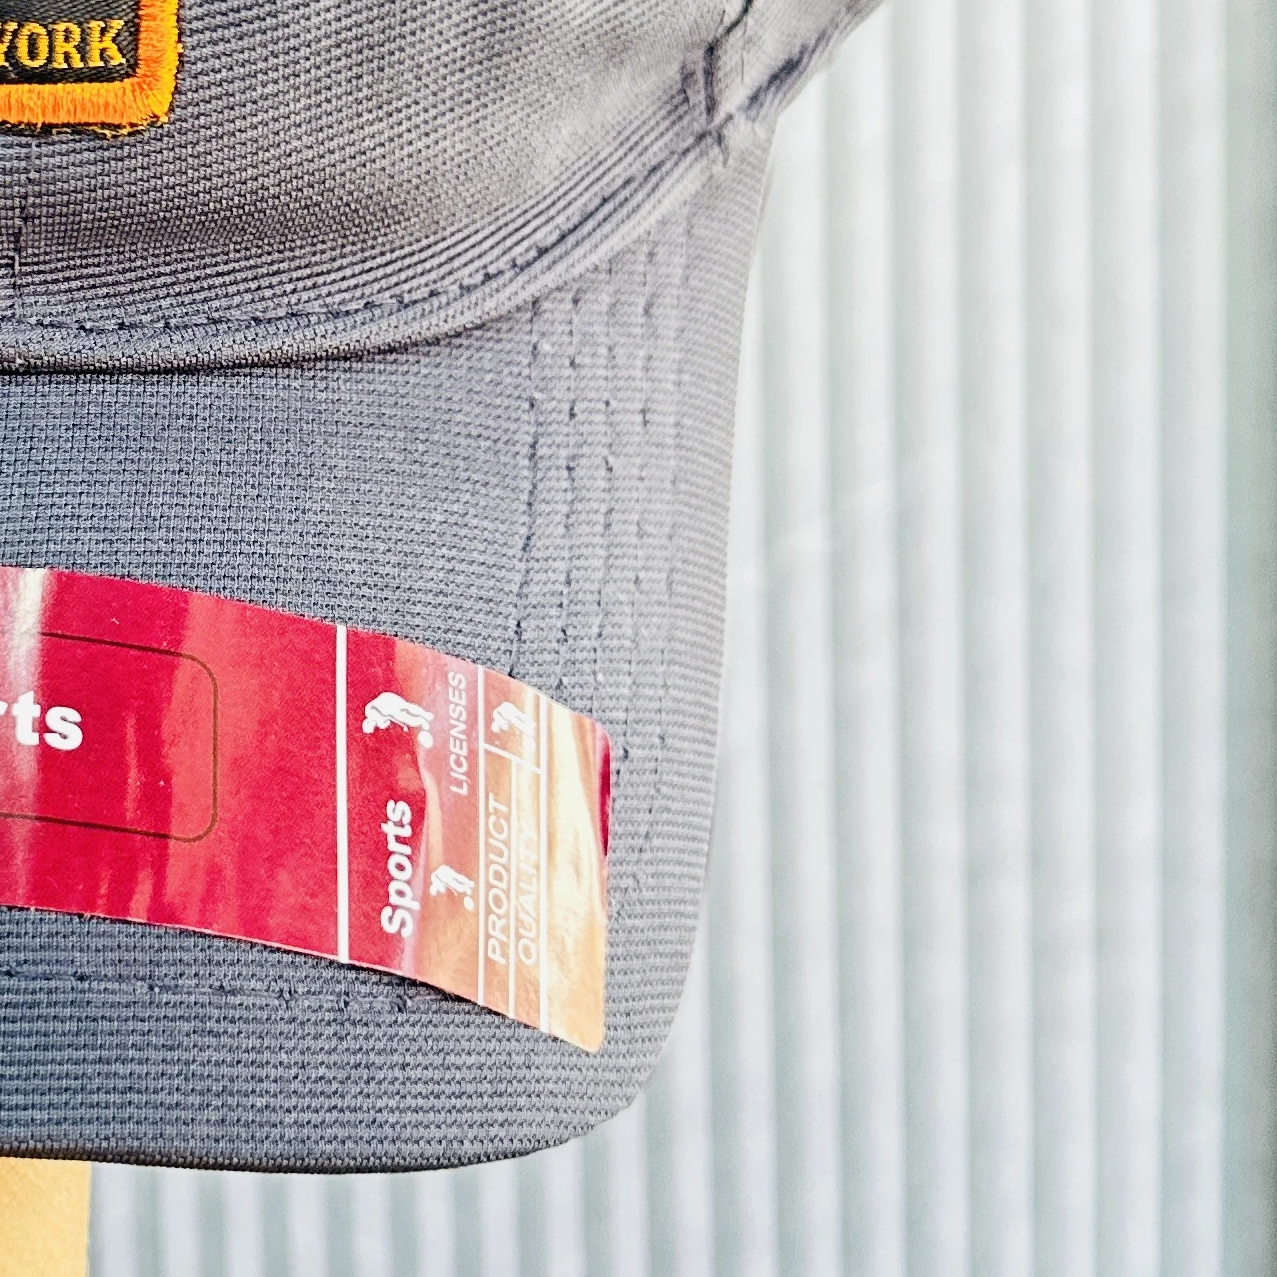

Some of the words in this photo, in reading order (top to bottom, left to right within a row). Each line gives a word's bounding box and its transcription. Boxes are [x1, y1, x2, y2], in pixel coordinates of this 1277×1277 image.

[447, 670, 468, 796] LICENSES
[380, 799, 420, 938] Sports
[486, 791, 510, 965] PRODUCT
[516, 821, 539, 967] QUALITY
